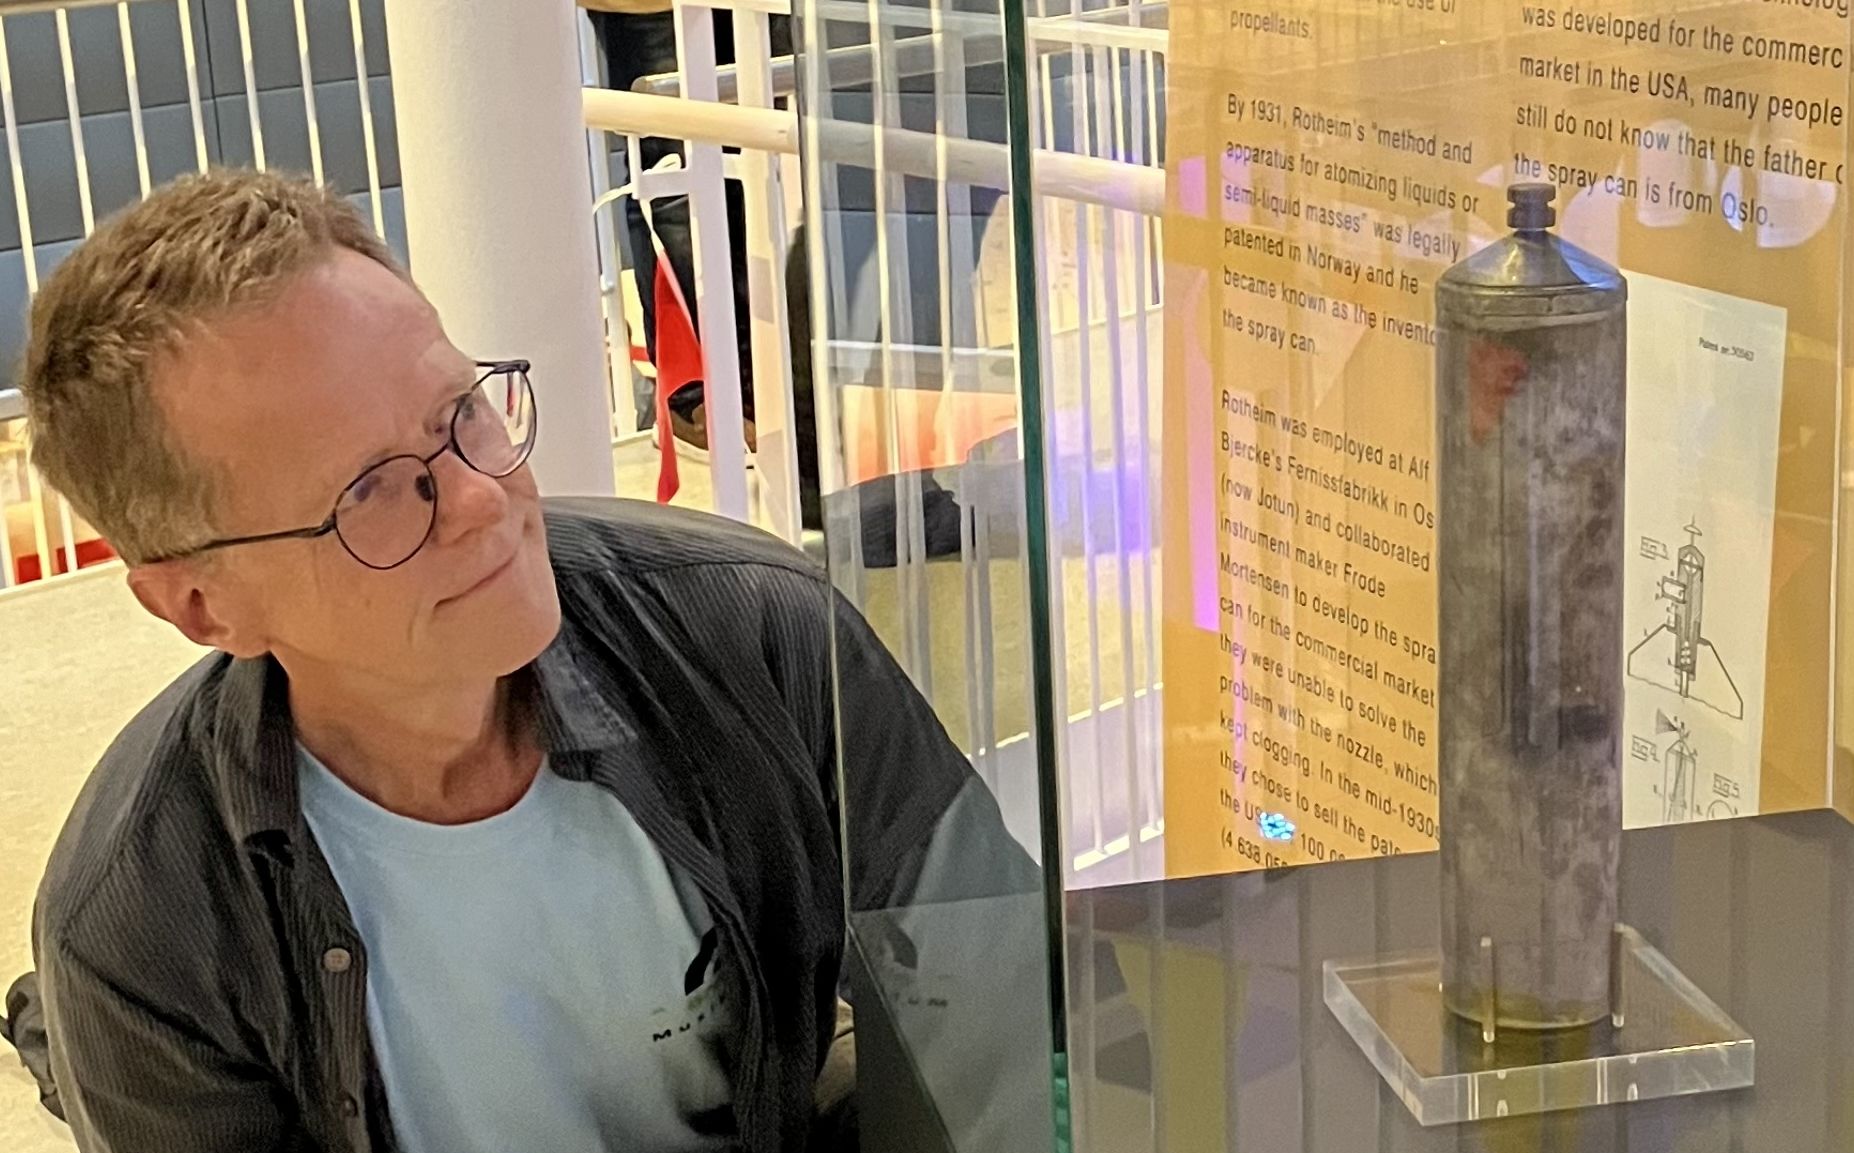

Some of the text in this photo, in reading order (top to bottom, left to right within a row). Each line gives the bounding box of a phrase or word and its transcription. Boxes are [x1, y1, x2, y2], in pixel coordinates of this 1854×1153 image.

[1230, 9, 1312, 39] propellants.
[1522, 6, 1844, 69] was developed for the commerc
[1228, 93, 1472, 163] By 1931, Rotheim's "method and
[1520, 54, 1843, 129] market in the USA, many people
[1226, 142, 1478, 213] apparatus for atomizing liquids or
[1516, 103, 1547, 129] still
[1554, 109, 1576, 134] do
[1584, 117, 1613, 142] not
[1620, 120, 1670, 151] know
[1678, 130, 1716, 161] that
[1724, 137, 1755, 168] the
[1763, 145, 1828, 181] father
[1225, 183, 1460, 263] semi-liquid masses" was legally
[1514, 152, 1775, 228] the spray can is from Oslo.
[1224, 227, 1418, 294] patented in Norway and he
[1224, 266, 1277, 298] became
[1281, 284, 1327, 313] known
[1332, 302, 1348, 320] as
[1354, 304, 1376, 328] the
[1223, 309, 1319, 355] the spray can.
[1222, 389, 1429, 482] Rotheim was employed at Alf
[1222, 431, 1282, 471] Bjercke's
[1288, 456, 1388, 510] Fernissfabrikk
[1394, 499, 1408, 519] in
[1221, 472, 1430, 572] (now Jotun) and collaborated
[1221, 513, 1386, 597] instrument maker Frode
[1220, 553, 1289, 599] Mortensen
[1295, 586, 1307, 607] to
[1312, 594, 1368, 635] develop
[1374, 623, 1398, 646] the
[1220, 596, 1435, 708] can for the commercial market
[1220, 635, 1426, 747] they were unable to solve the
[1220, 675, 1437, 796] problem with the nozzle, which
[1220, 711, 1247, 741] kept
[1252, 732, 1315, 777] clogging.
[1320, 761, 1333, 785] In
[1338, 773, 1361, 798] the
[1220, 750, 1247, 783] they
[1252, 769, 1291, 802] chose
[1296, 791, 1309, 811] to
[1314, 803, 1338, 827] sell
[1343, 815, 1365, 844] the
[1220, 789, 1241, 814] the
